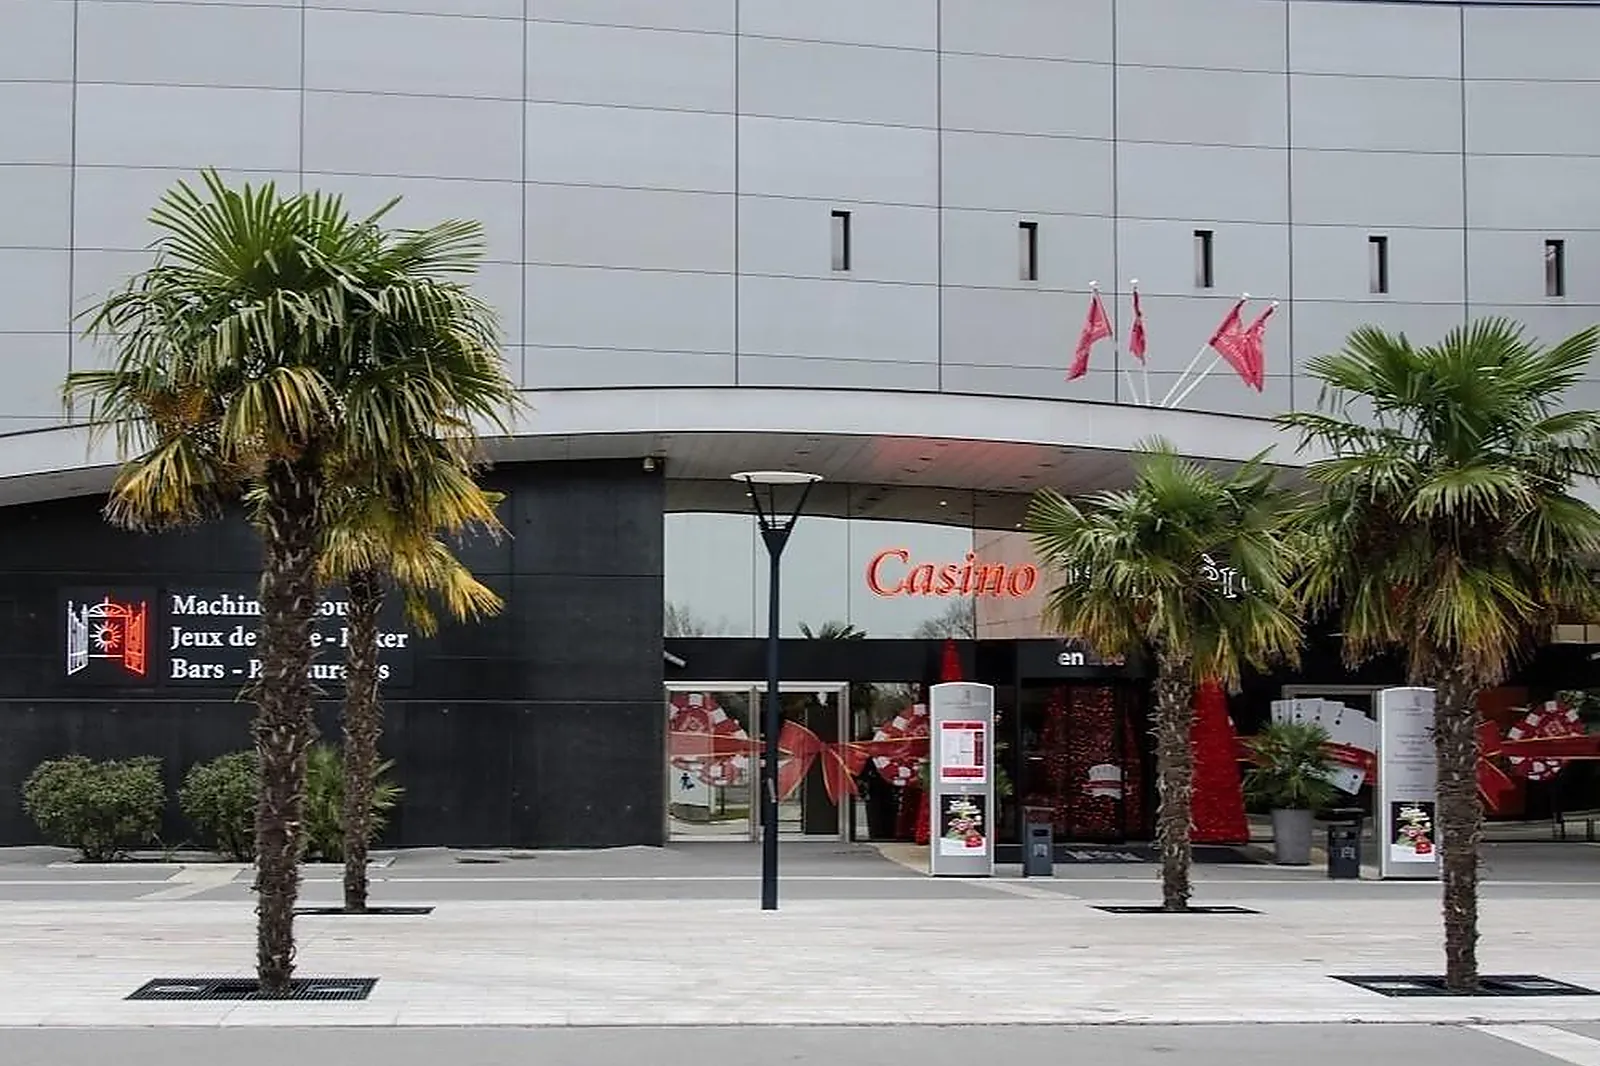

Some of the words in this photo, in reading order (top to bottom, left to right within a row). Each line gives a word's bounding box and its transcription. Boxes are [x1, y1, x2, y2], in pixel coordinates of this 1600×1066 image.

[867, 549, 1038, 597] Casino
[171, 594, 266, 615] Machin
[170, 626, 224, 650] Jeux
[229, 625, 257, 647] de
[340, 628, 409, 648] ker
[170, 658, 225, 679] Bars
[1058, 652, 1085, 666] en
